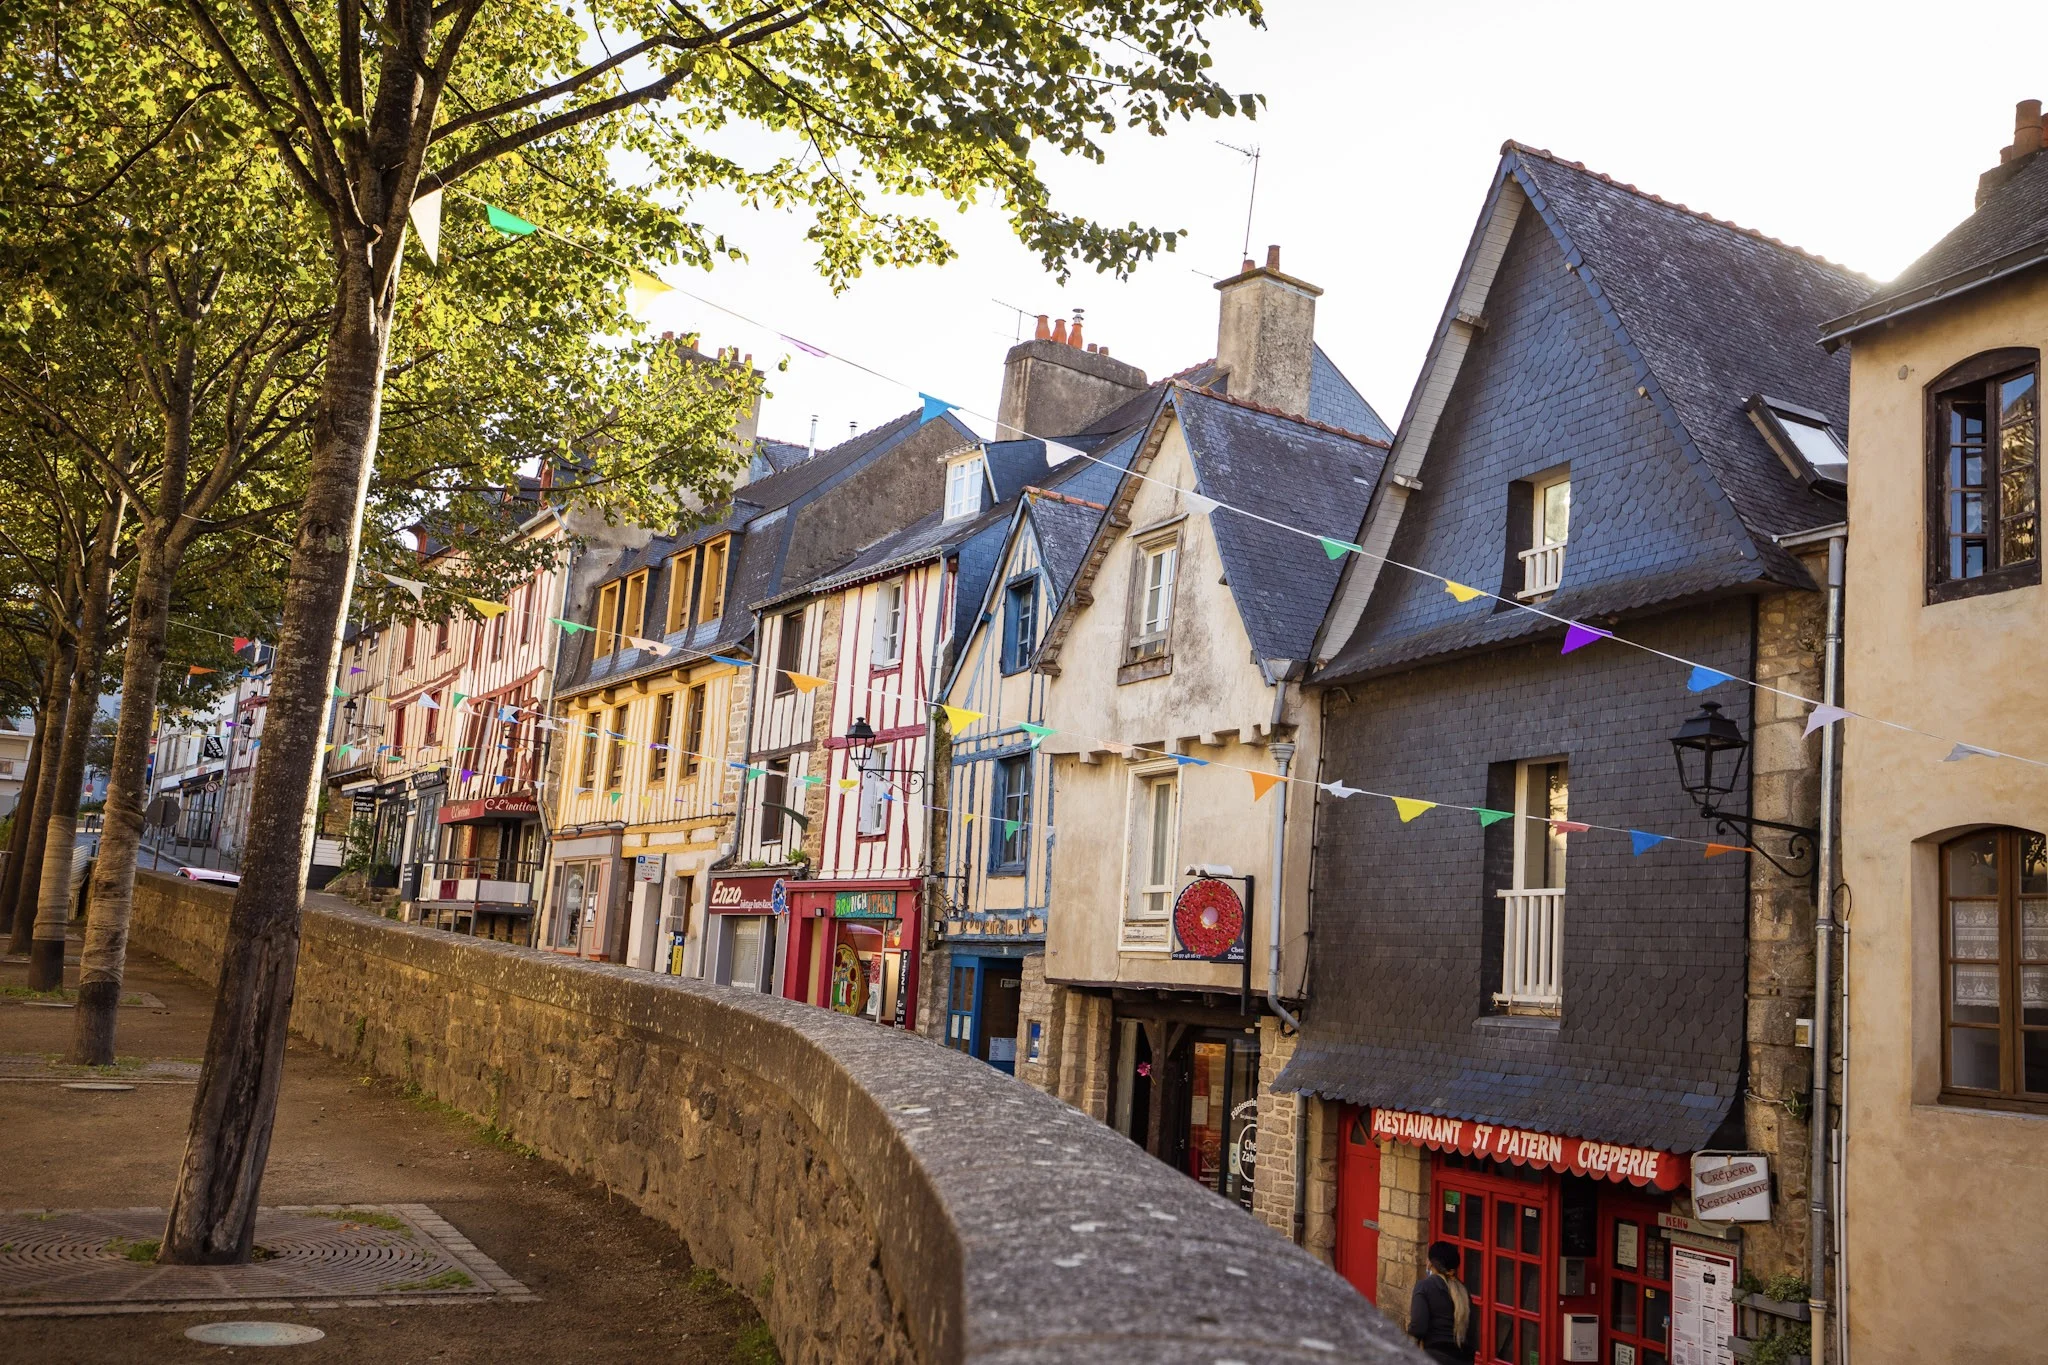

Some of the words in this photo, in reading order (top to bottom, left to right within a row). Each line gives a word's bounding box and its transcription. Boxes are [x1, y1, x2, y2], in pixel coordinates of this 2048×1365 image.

[711, 881, 742, 904] Enzo
[835, 893, 867, 916] BRUNCH
[867, 894, 894, 915] ITALY
[675, 936, 682, 946] P
[1245, 1139, 1257, 1151] Che
[1374, 1108, 1463, 1146] RESTAURANT
[1473, 1124, 1493, 1150] ST
[1498, 1129, 1562, 1163] PATERN
[1700, 1164, 1757, 1184] Crêperie
[1697, 1182, 1769, 1213] Restaurant
